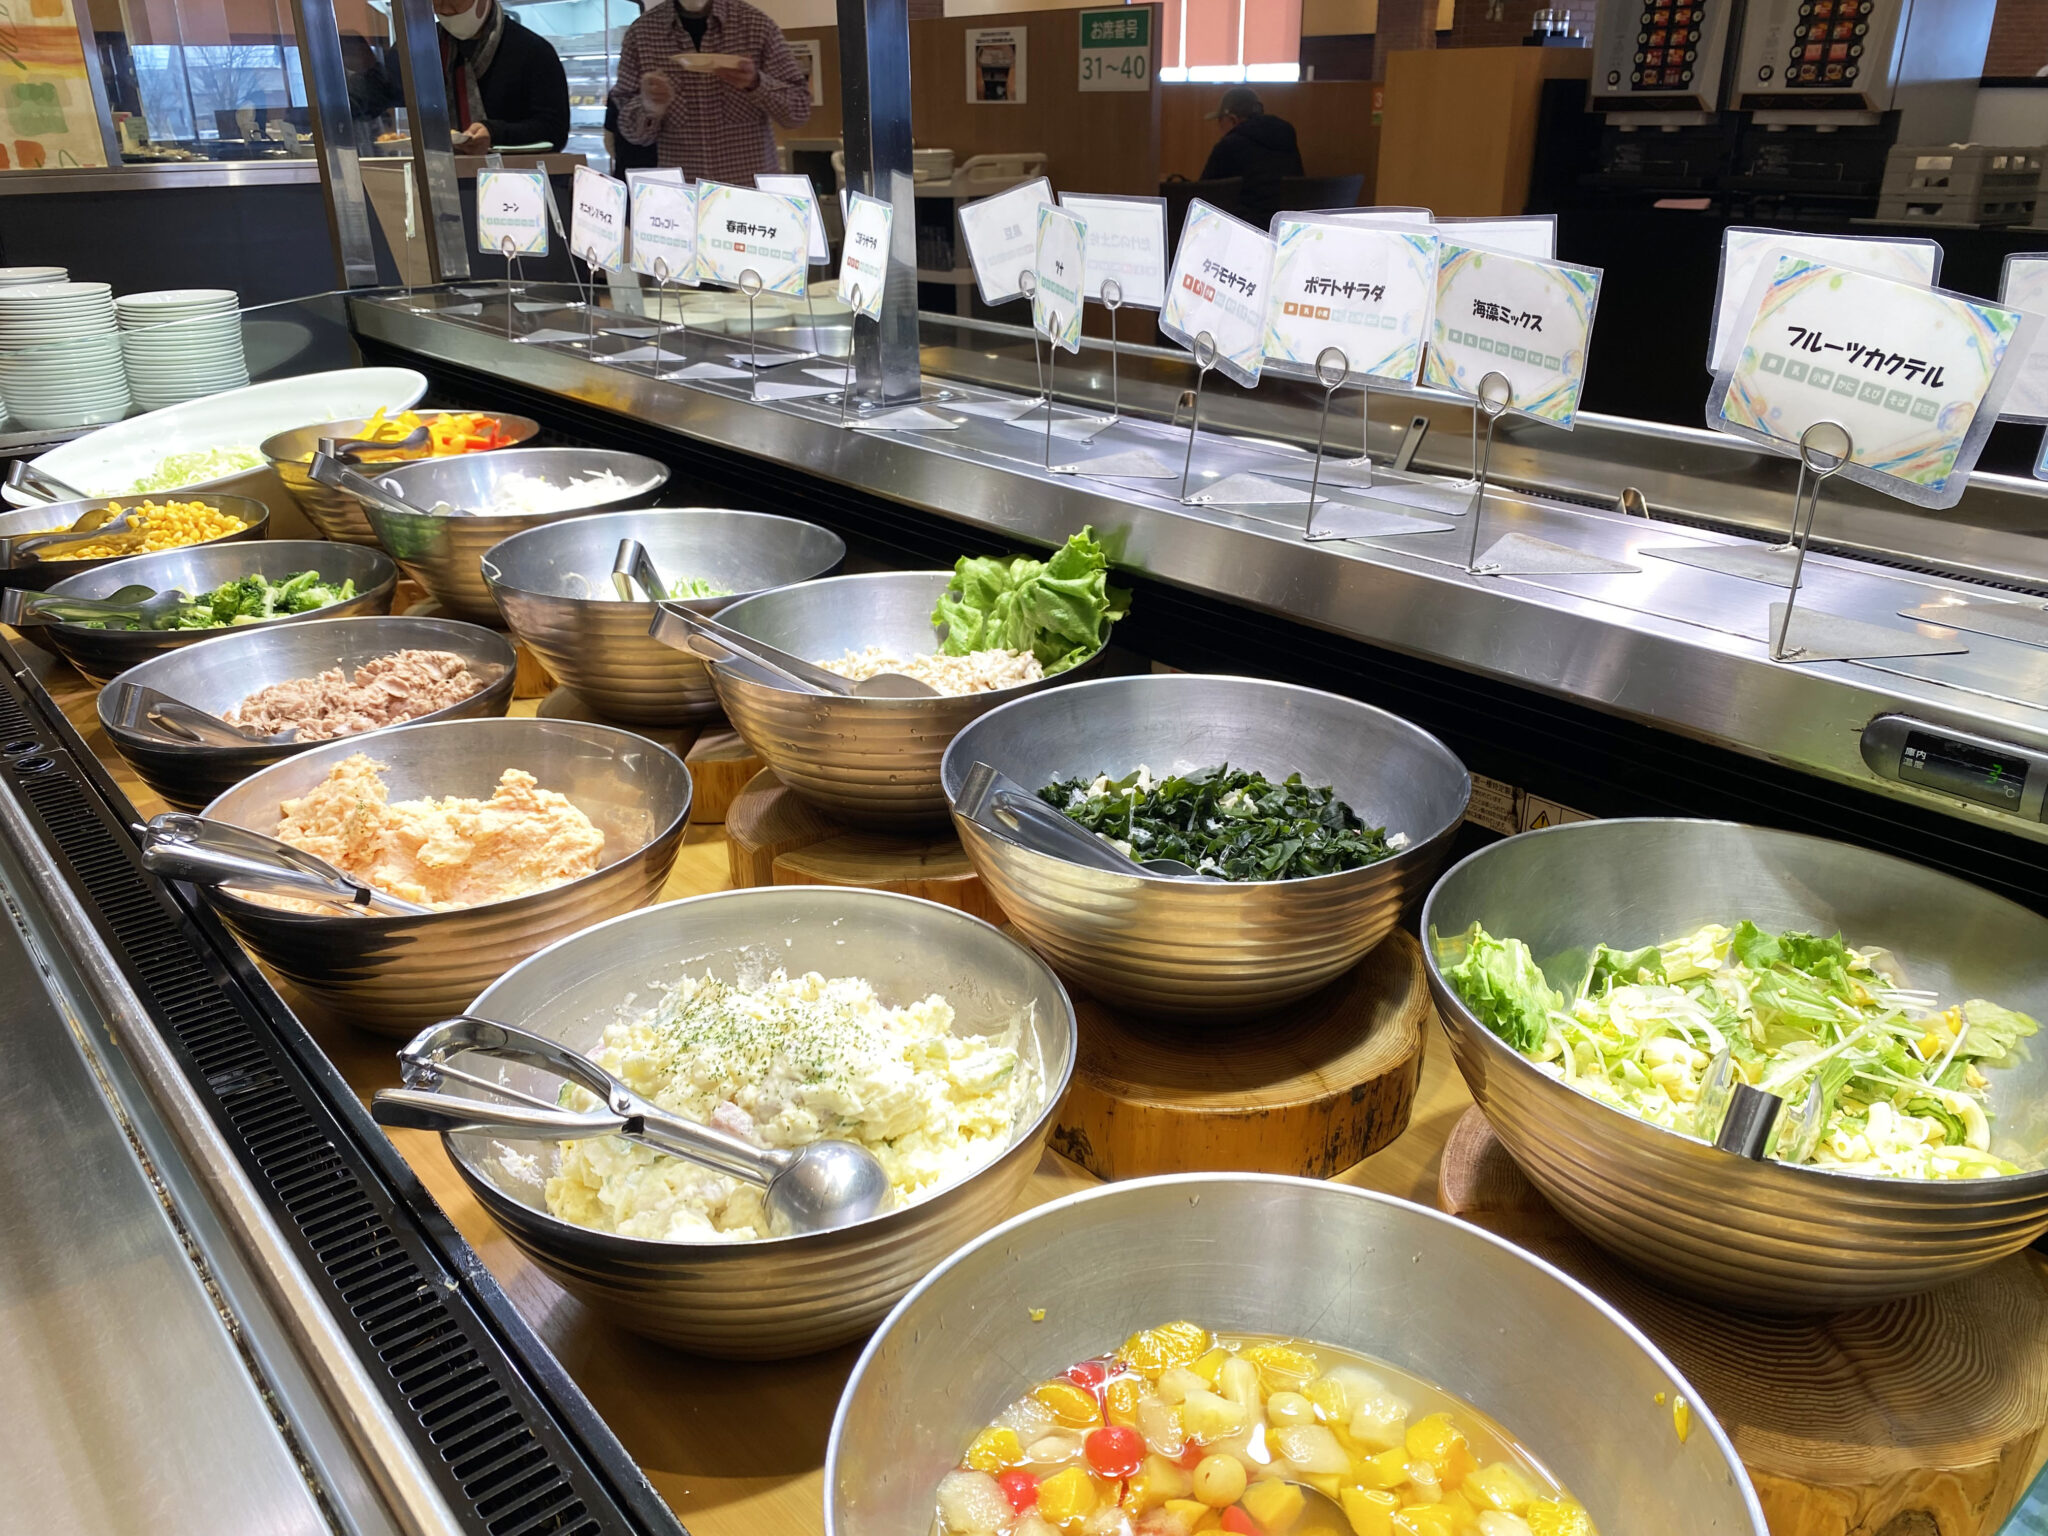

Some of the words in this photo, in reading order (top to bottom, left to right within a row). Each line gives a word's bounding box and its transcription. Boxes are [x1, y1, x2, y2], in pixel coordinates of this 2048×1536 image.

[1091, 20, 1139, 39] お席番号
[503, 203, 519, 213] コーン
[726, 220, 777, 239] 春雨サラダ
[1203, 258, 1256, 297] タラモサラダ
[1304, 276, 1386, 303] ポテトサラダ
[1472, 298, 1543, 332] 海藻ミックス
[1788, 325, 1945, 388] フルーツカクテル
